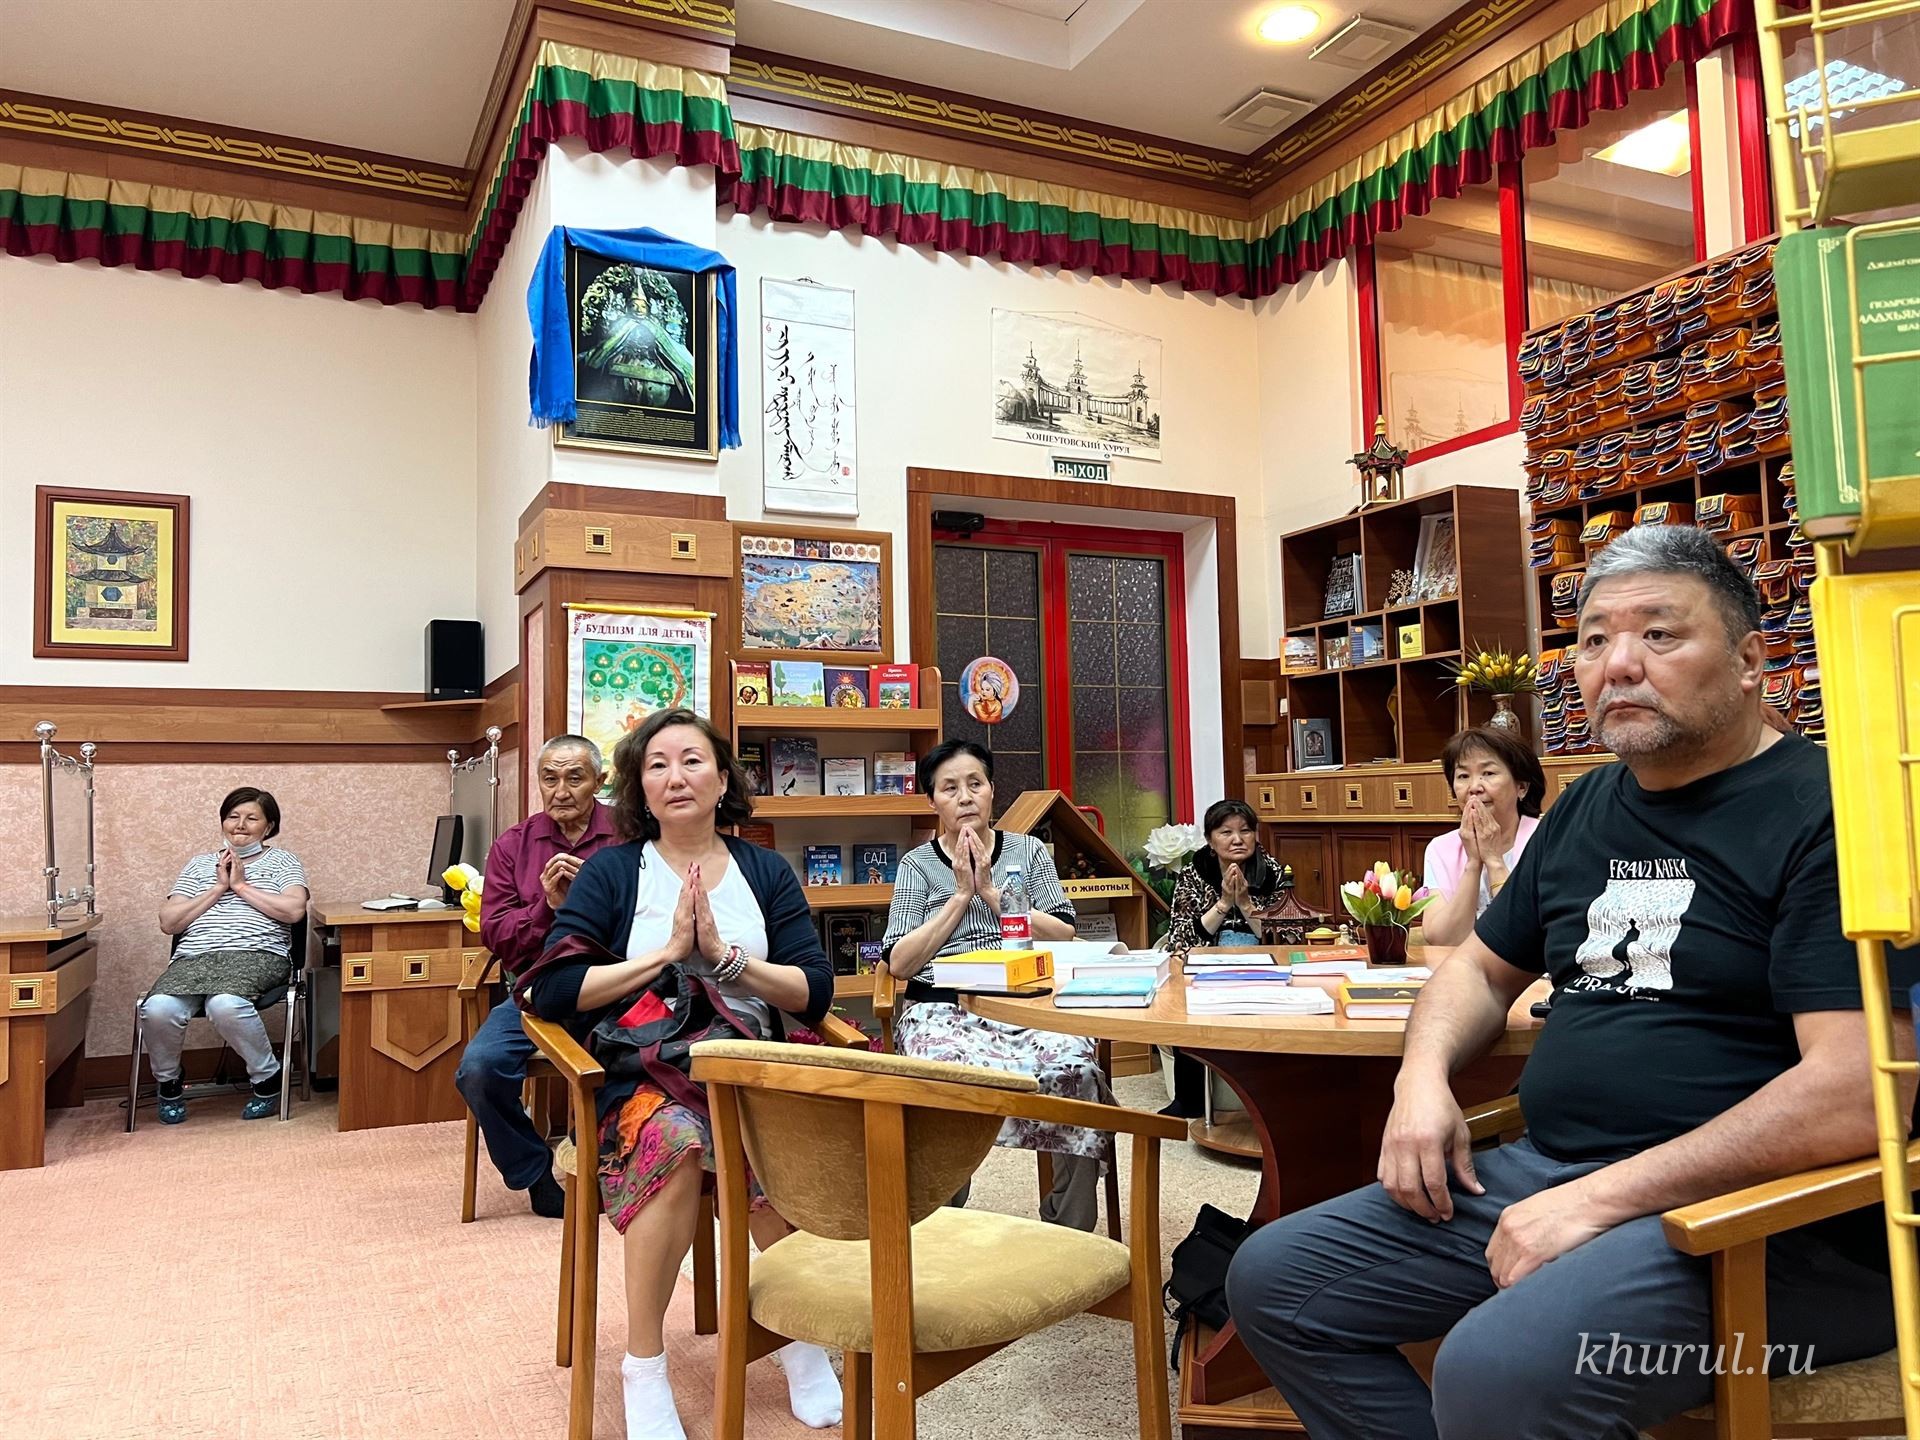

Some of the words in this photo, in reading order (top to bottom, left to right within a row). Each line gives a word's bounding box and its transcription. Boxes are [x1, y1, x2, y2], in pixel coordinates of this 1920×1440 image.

[1026, 431, 1101, 450] ХОШЕУТОВСКИЙ
[1103, 443, 1130, 454] ХУРУЛ
[1057, 463, 1105, 480] ВЫХОД
[586, 624, 634, 635] БУДДИЗМ
[639, 627, 658, 636] ДЛЯ
[662, 629, 693, 639] ДЕТЕЙ
[905, 780, 913, 790] 4
[863, 852, 888, 866] САД
[1609, 859, 1652, 879] FRANZ
[1654, 858, 1689, 879] KAFKA
[1080, 884, 1130, 893] ЖИВОТНЫХ
[860, 945, 881, 954] ПРИТЧ
